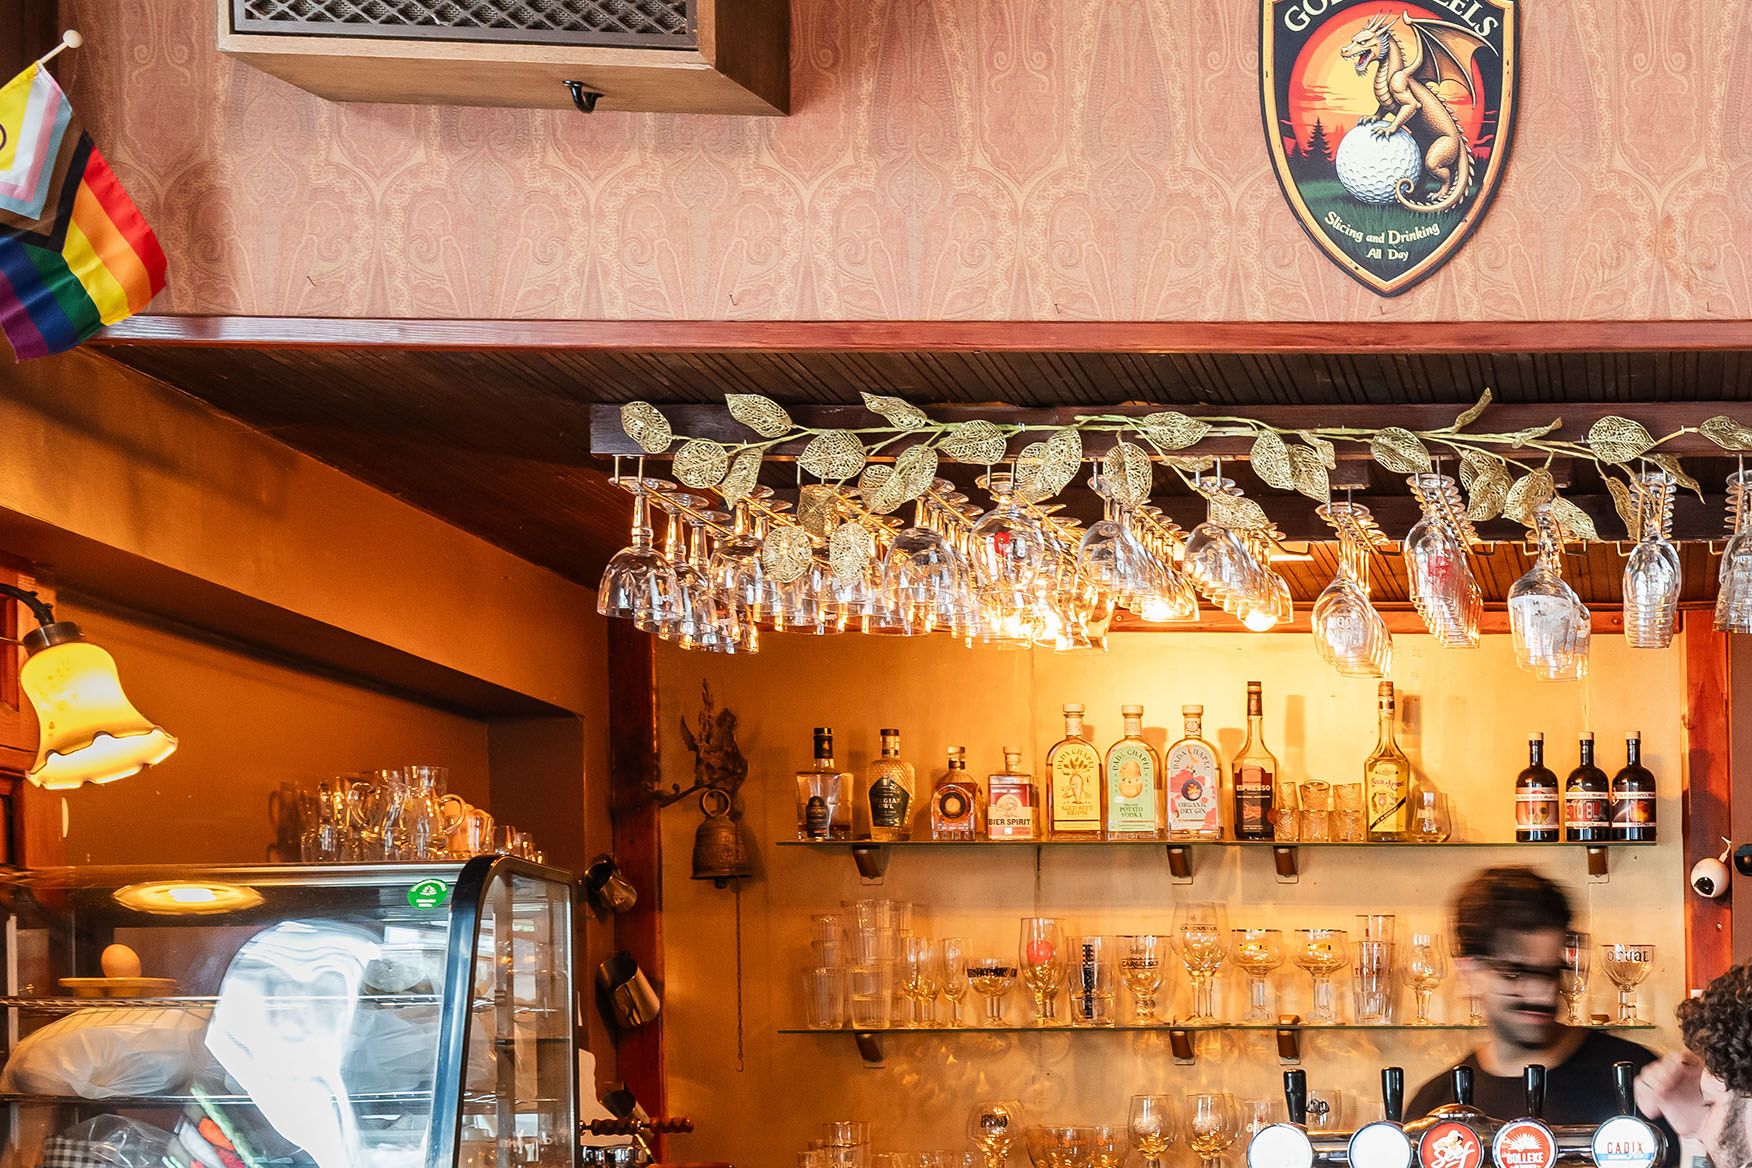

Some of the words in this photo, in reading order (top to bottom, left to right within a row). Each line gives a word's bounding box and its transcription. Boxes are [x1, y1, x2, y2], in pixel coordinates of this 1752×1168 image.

[1324, 211, 1364, 243] Slicing
[1366, 232, 1385, 243] and
[1388, 223, 1441, 245] Drinking
[1366, 248, 1382, 259] All
[1388, 249, 1409, 261] Day
[1126, 749, 1151, 771] CHAPEL
[988, 818, 1005, 826] BIER
[1006, 818, 1031, 826] SPIRIT
[1607, 1142, 1644, 1153] CADIX
[1506, 1151, 1544, 1164] BOLLEKE
